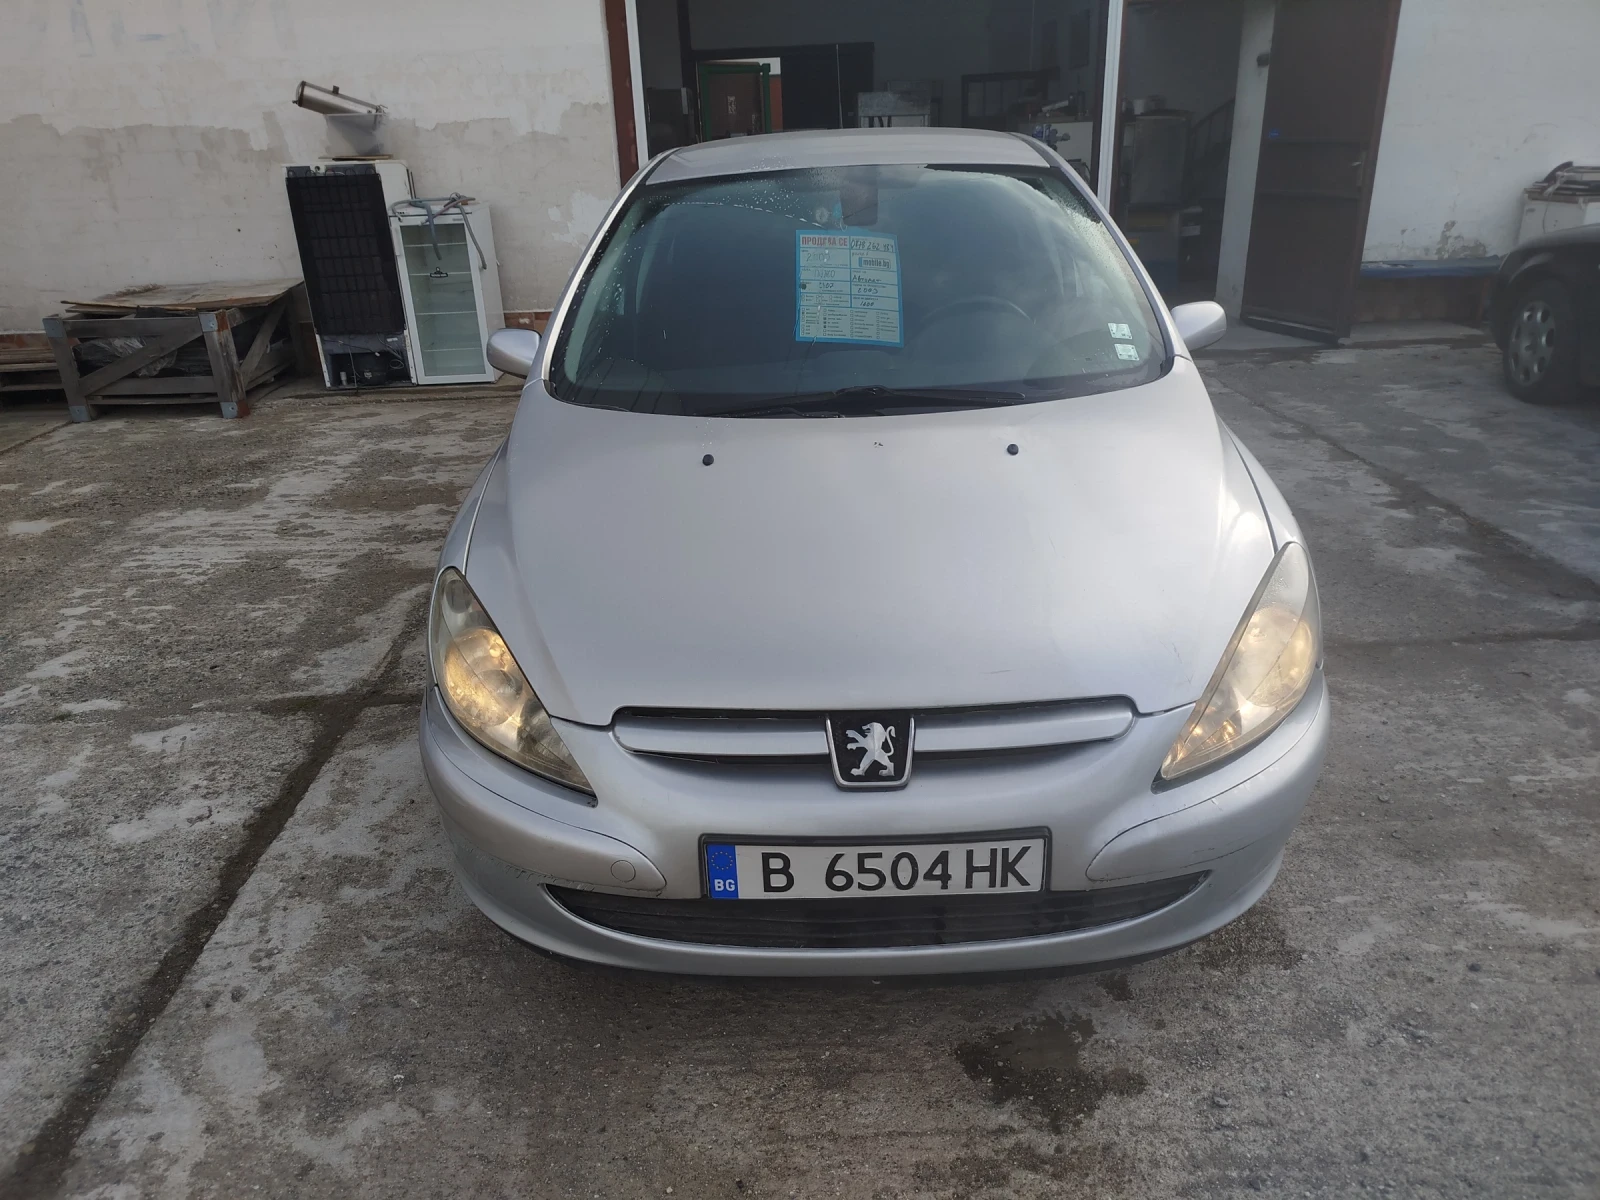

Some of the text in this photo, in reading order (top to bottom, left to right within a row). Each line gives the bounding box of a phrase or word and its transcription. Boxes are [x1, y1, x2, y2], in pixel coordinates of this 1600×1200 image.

[838, 237, 848, 247] СЕ
[863, 257, 890, 269] mobile.bg
[761, 846, 1032, 893] B 6504 HK
[714, 879, 736, 892] BG
